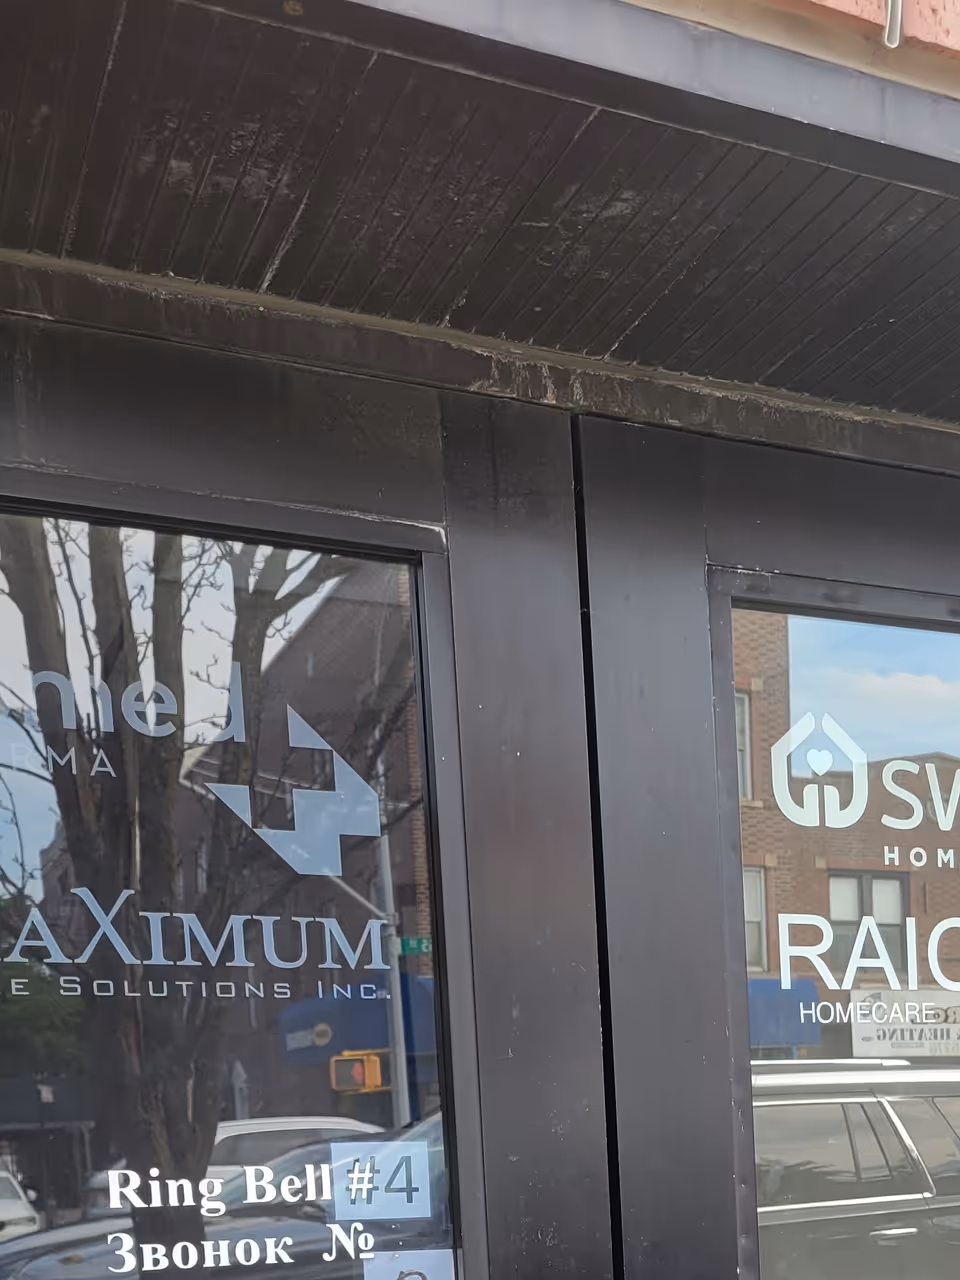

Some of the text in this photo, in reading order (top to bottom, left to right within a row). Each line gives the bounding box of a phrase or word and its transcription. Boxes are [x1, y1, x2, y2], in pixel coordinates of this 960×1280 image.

[60, 976, 292, 998] SOLUTIONS
[799, 1002, 936, 1024] HOMECARE
[108, 1167, 225, 1216] Ring
[244, 1163, 333, 1205] Bell
